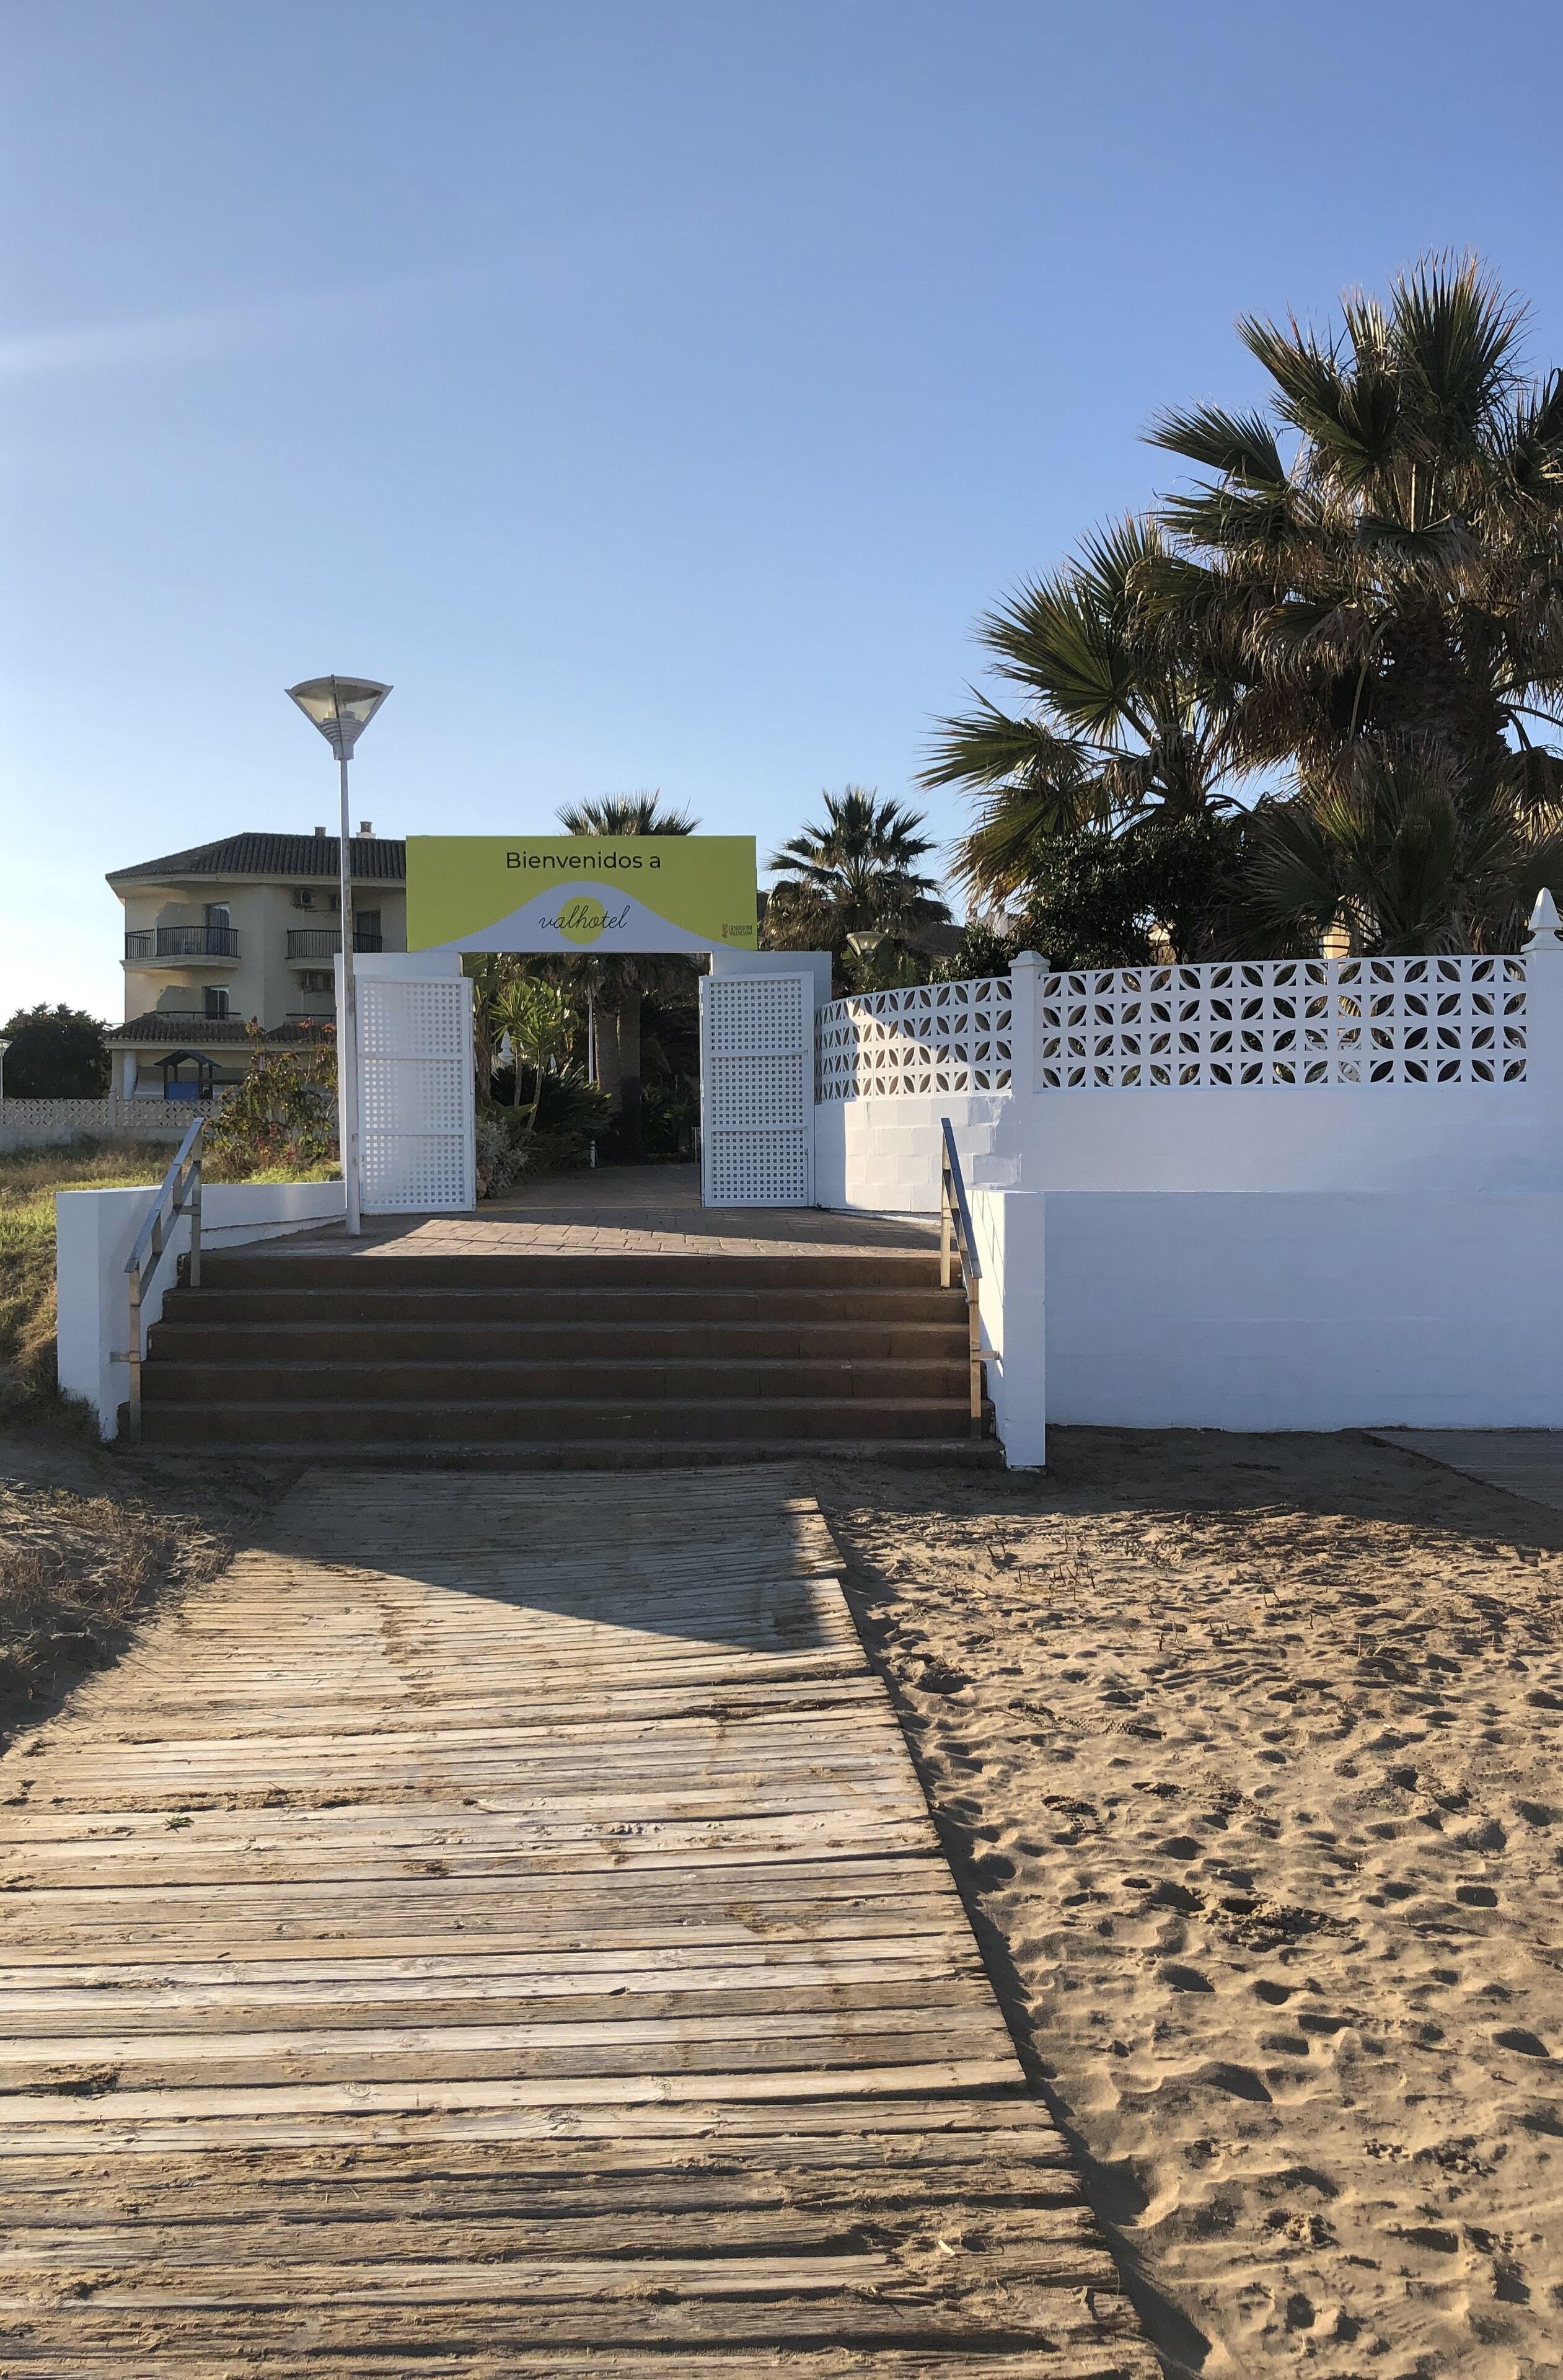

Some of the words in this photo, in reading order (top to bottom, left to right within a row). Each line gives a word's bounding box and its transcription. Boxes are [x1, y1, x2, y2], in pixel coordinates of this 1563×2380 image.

[506, 851, 643, 869] Bienvenidos
[649, 856, 661, 869] a
[538, 905, 630, 930] valhotel
